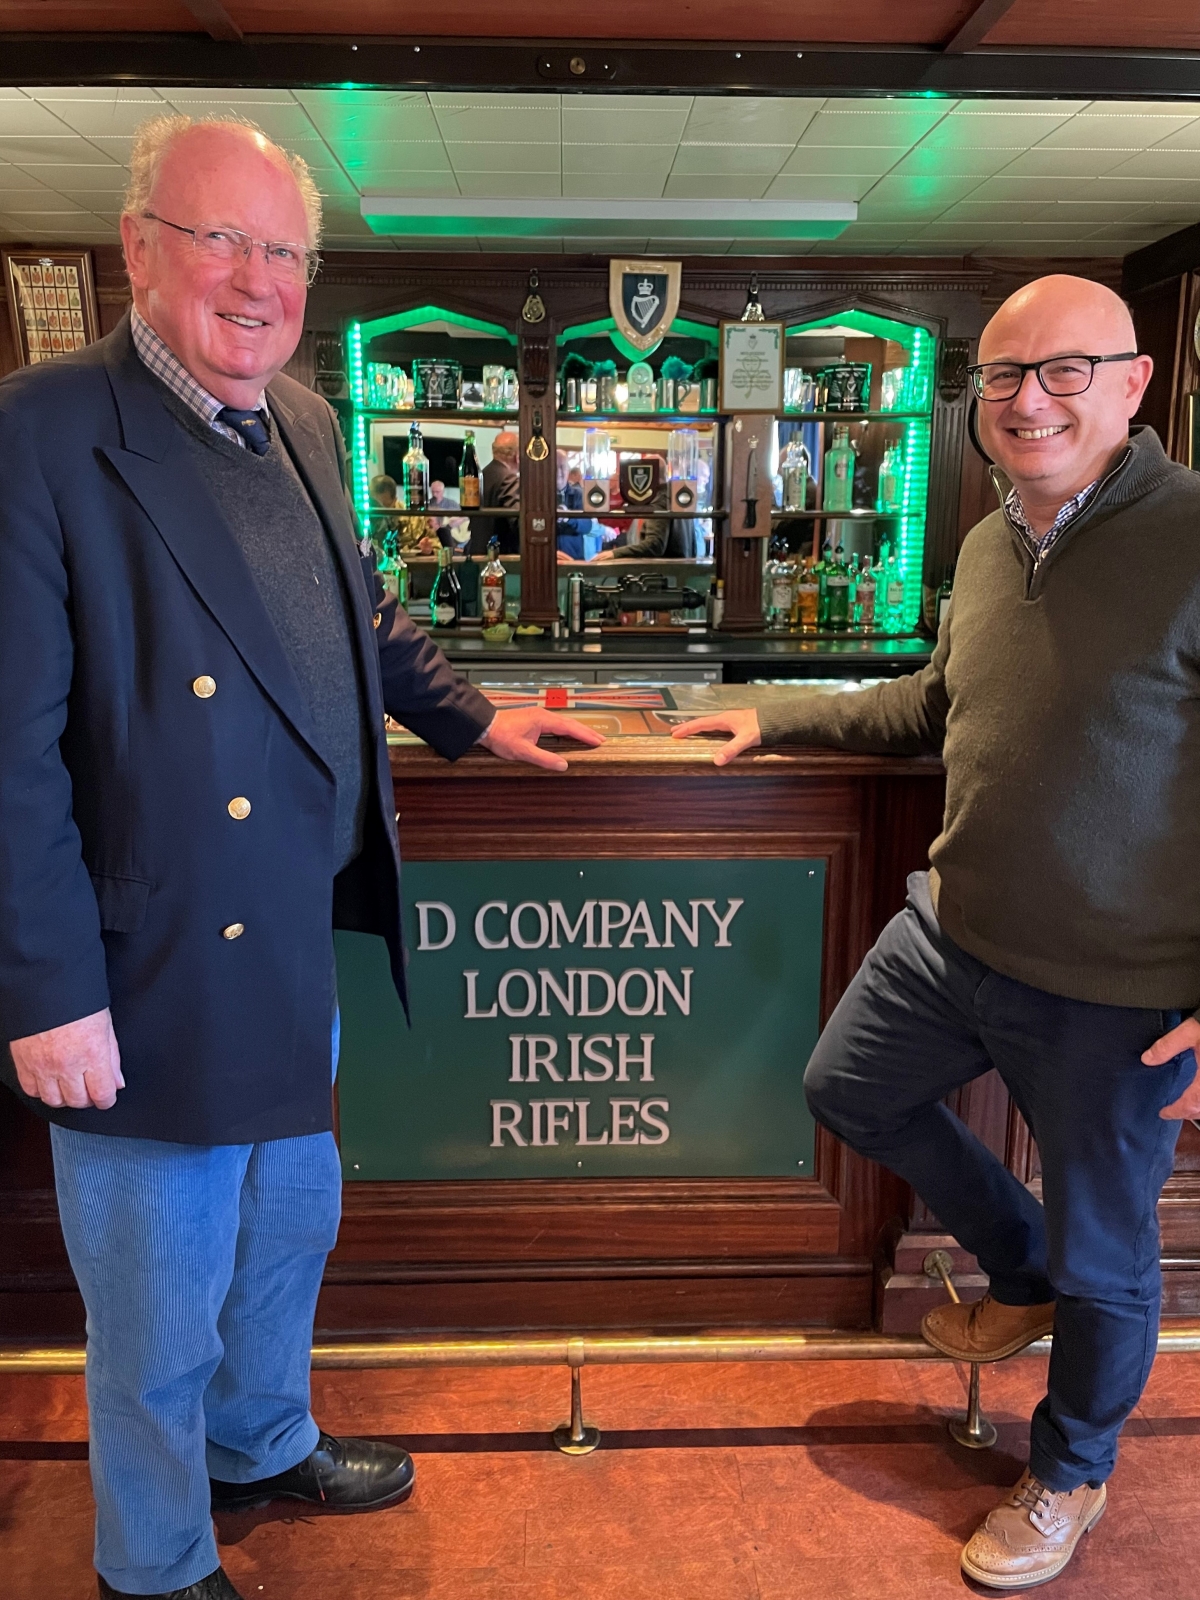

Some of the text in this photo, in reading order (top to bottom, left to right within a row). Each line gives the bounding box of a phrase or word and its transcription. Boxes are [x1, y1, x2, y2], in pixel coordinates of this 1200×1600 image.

[415, 898, 744, 950] D COMPANY
[463, 967, 694, 1018] LONDON
[508, 1033, 655, 1082] IRISH
[490, 1097, 670, 1147] RIFLES
